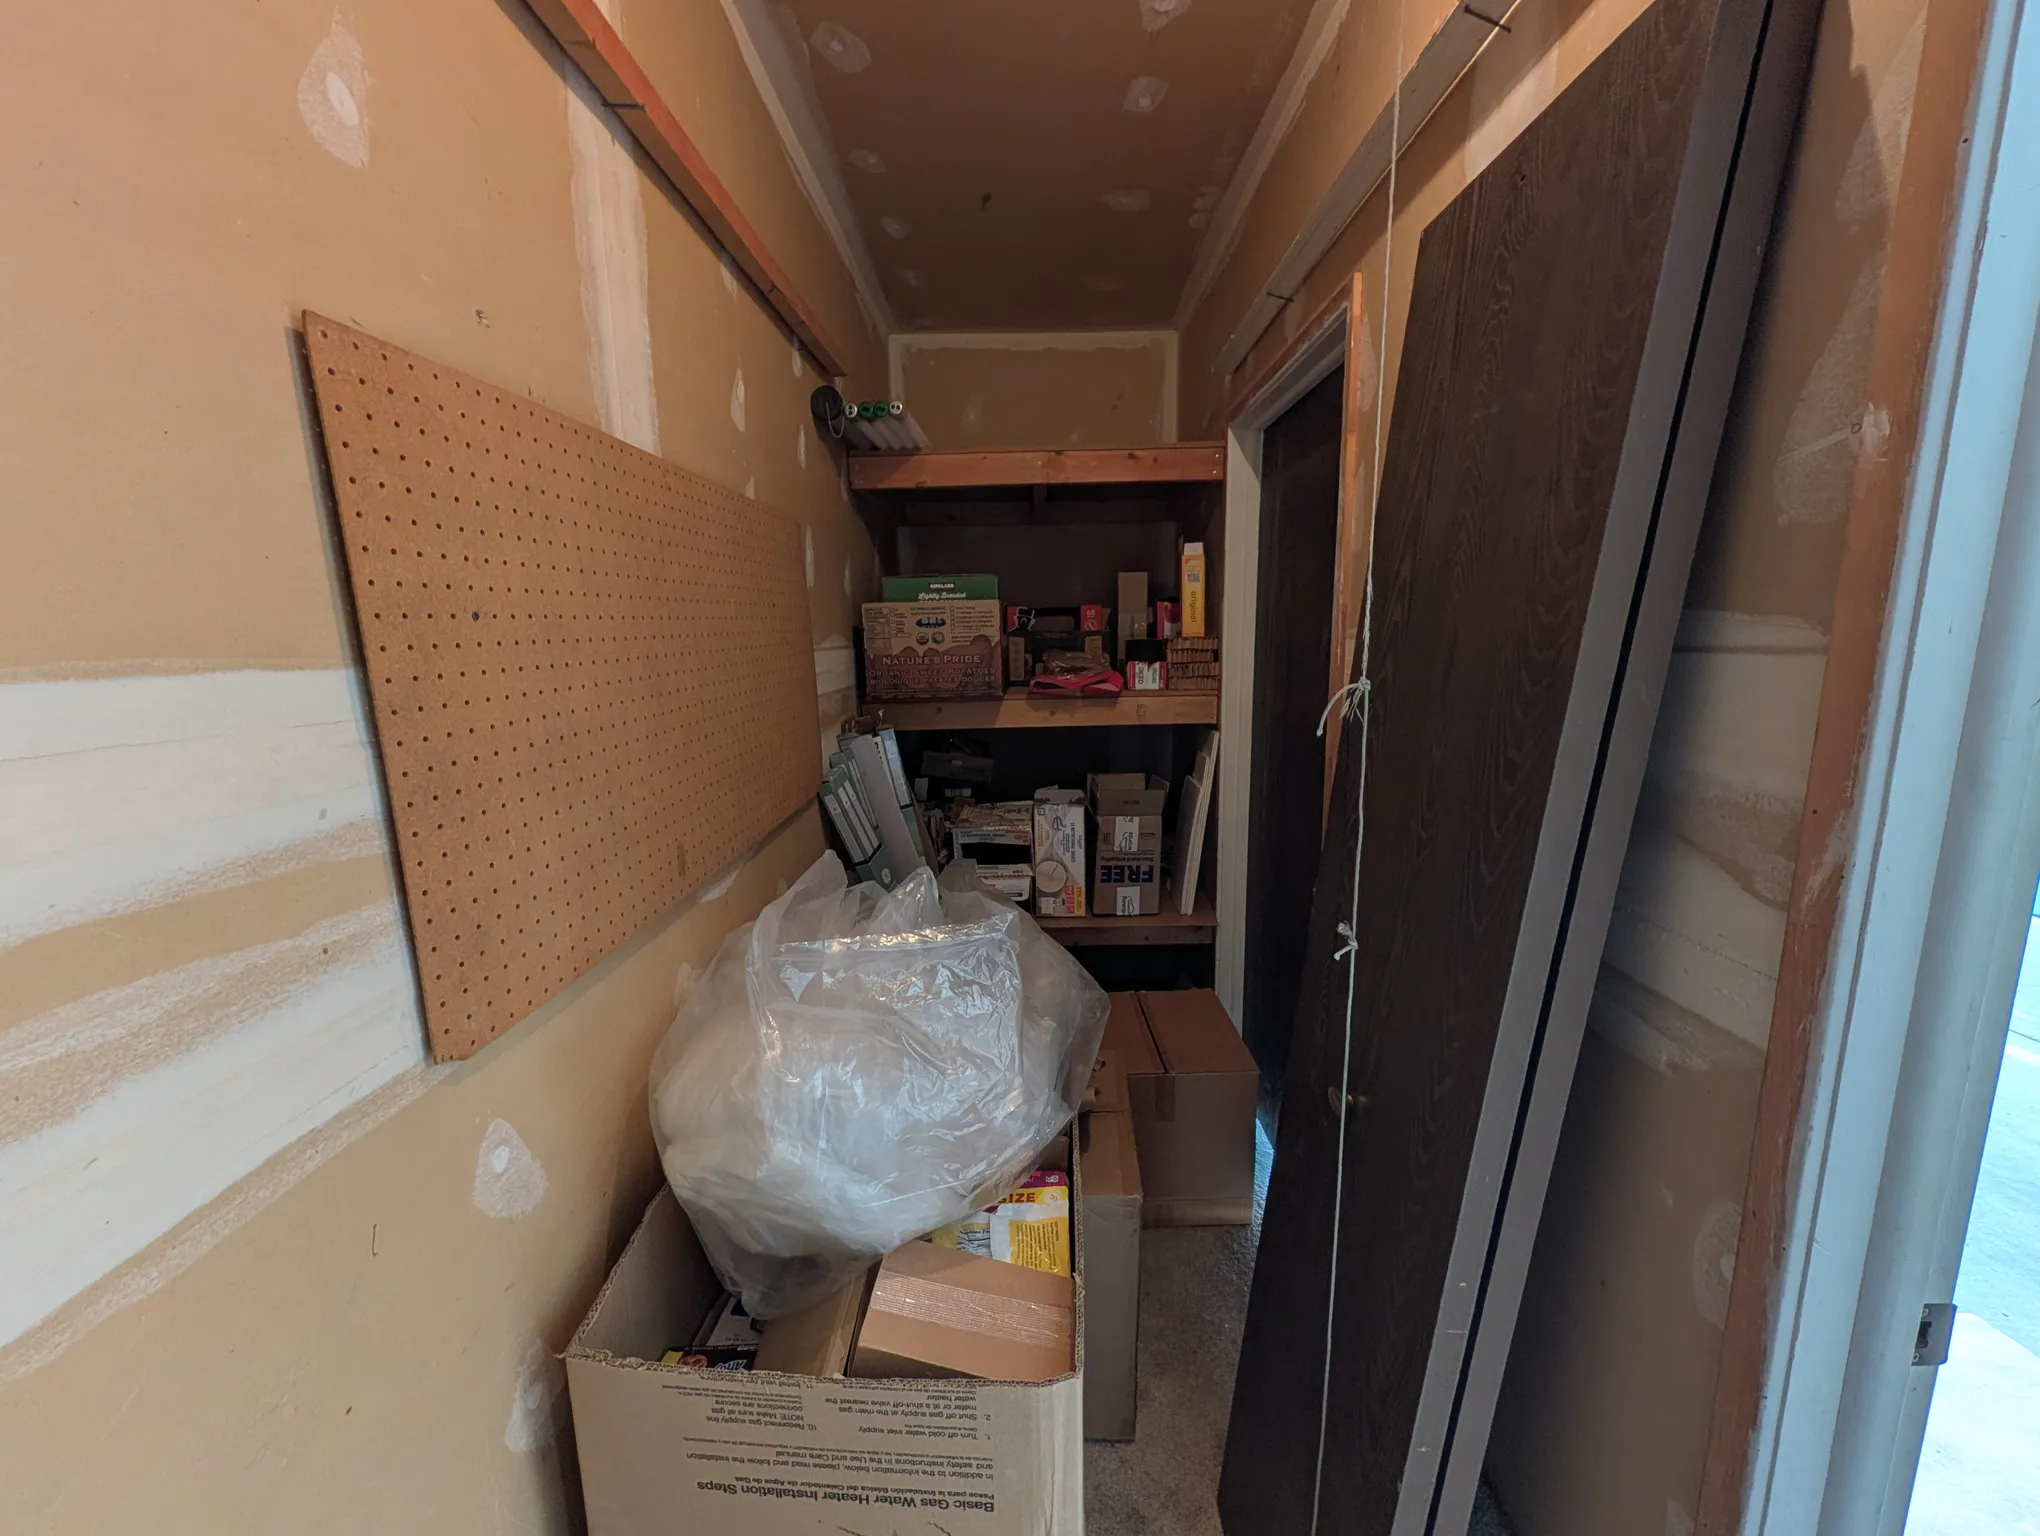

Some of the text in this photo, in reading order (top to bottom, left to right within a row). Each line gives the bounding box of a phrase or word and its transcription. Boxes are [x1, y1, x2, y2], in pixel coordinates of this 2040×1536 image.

[1188, 590, 1198, 623] original
[882, 655, 981, 666] NATURE'S PRIDE
[869, 669, 909, 677] ORGANIC
[948, 668, 996, 676] POTATOES
[1137, 667, 1145, 684] DICED
[1101, 855, 1125, 863] shipping
[1100, 865, 1154, 883] FREE
[756, 1402, 803, 1412] connections
[892, 1401, 924, 1409] shut-off
[756, 1411, 777, 1419] Make
[720, 1416, 746, 1424] supply
[748, 1418, 762, 1426] gas
[764, 1420, 804, 1430] Reconnect
[858, 1426, 884, 1434] supply
[686, 1452, 730, 1462] installation
[732, 1456, 744, 1464] the
[809, 1453, 829, 1461] Care
[850, 1456, 866, 1464] Use
[747, 1458, 770, 1466] follow
[812, 1462, 840, 1470] please
[895, 1458, 944, 1468] instructions
[946, 1460, 972, 1470] safety
[842, 1464, 869, 1473] below,
[948, 1471, 983, 1479] addition
[764, 1478, 785, 1486] Agua
[800, 1481, 844, 1490] Calentador
[696, 1480, 994, 1512] Basic Gas Water Heater Installation Steps
[969, 1492, 994, 1500] Pasos
